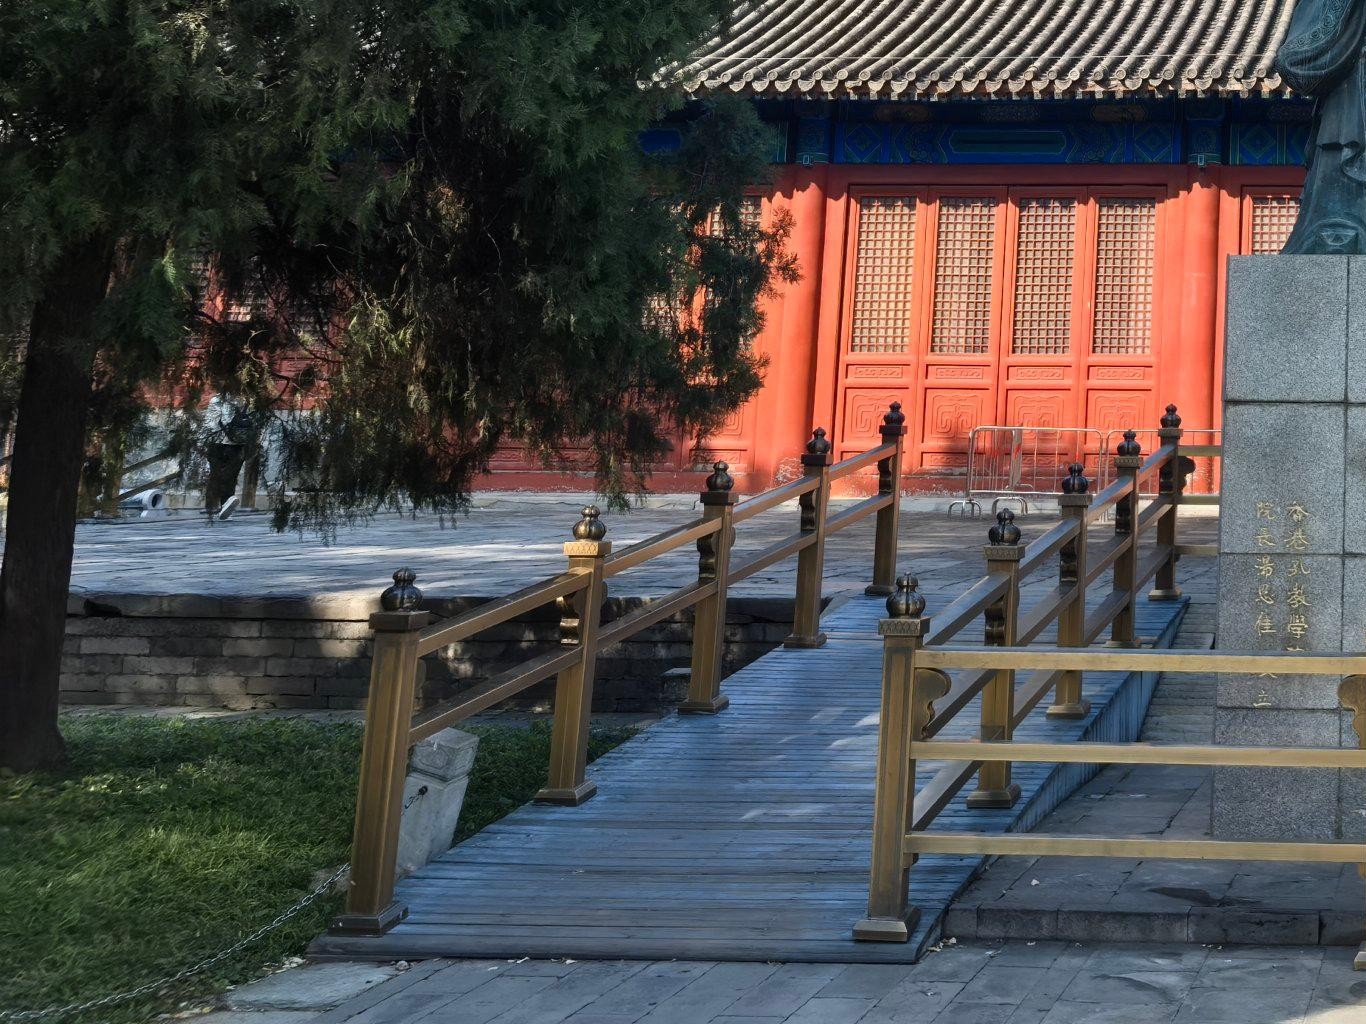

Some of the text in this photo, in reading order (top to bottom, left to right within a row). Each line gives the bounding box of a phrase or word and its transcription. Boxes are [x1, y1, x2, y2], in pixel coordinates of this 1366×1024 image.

[1254, 500, 1278, 707] 院長湯恩佳立
[1284, 500, 1312, 653] 香港孔教學
